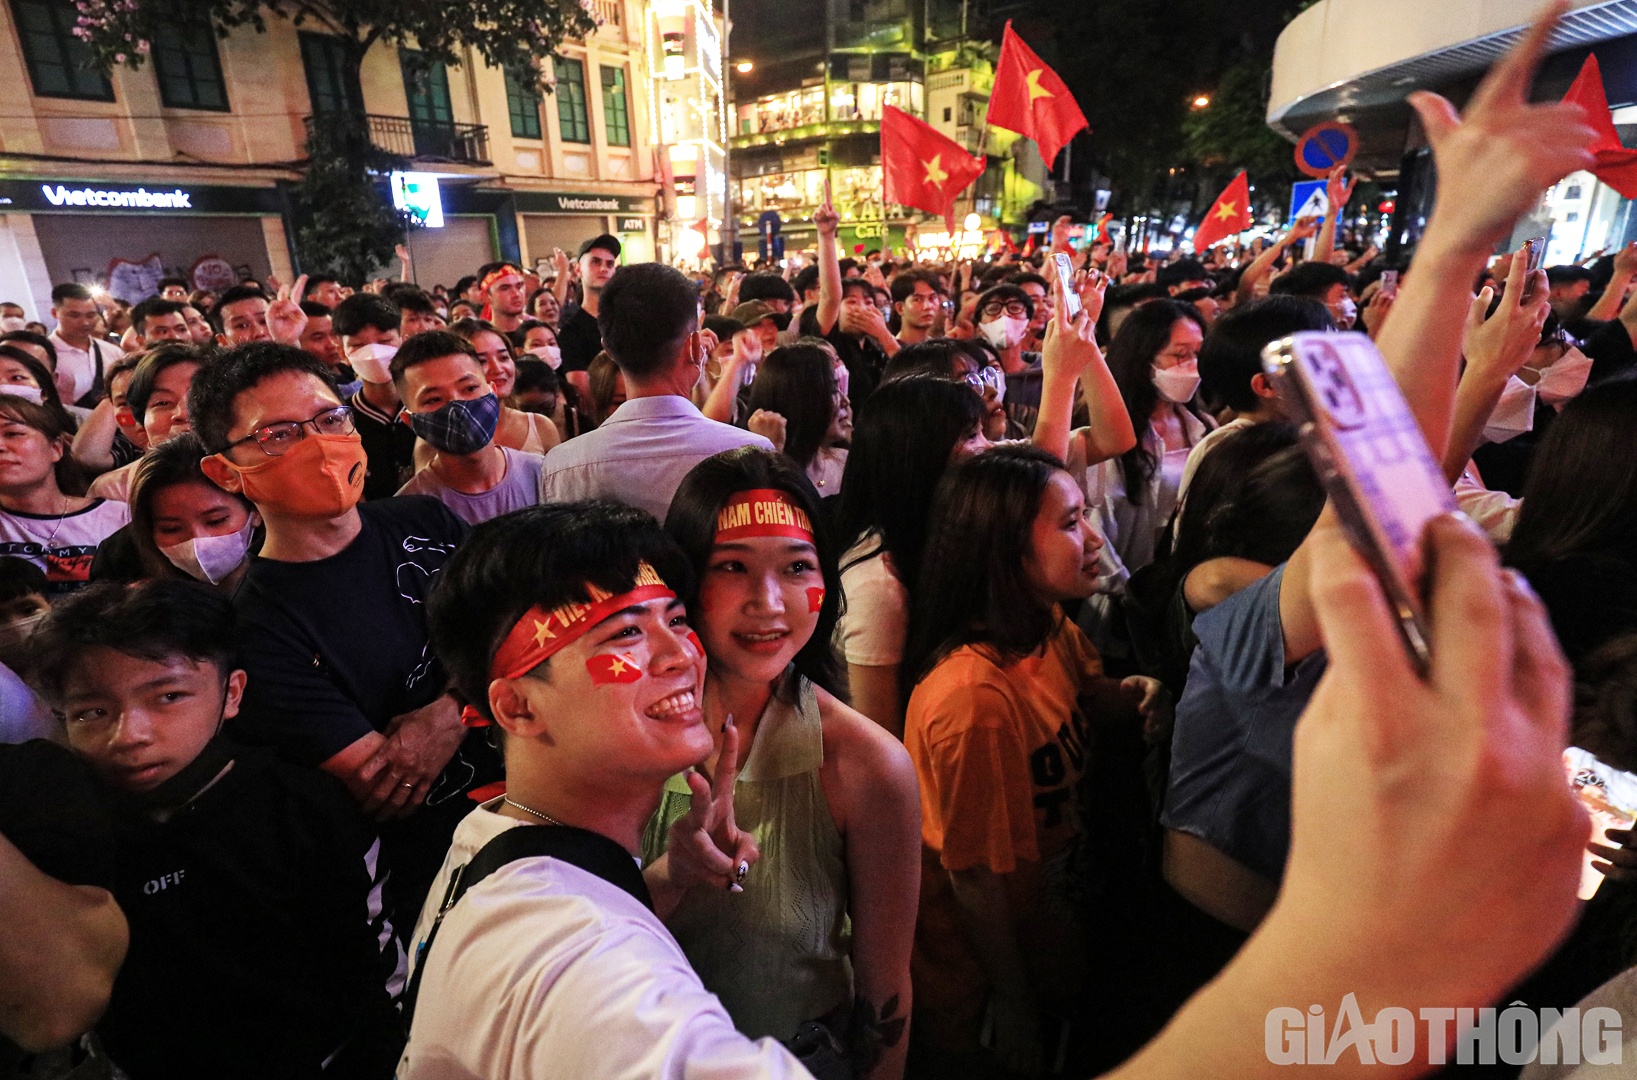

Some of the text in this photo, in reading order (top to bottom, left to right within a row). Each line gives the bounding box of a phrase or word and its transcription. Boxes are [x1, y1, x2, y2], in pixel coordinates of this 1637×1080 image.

[42, 185, 192, 208] Vietcombank
[558, 197, 619, 210] Vietcombank
[624, 219, 643, 229] ATM
[717, 503, 751, 531] NAM
[754, 497, 795, 526] CHIẾN
[143, 869, 185, 895] OFF
